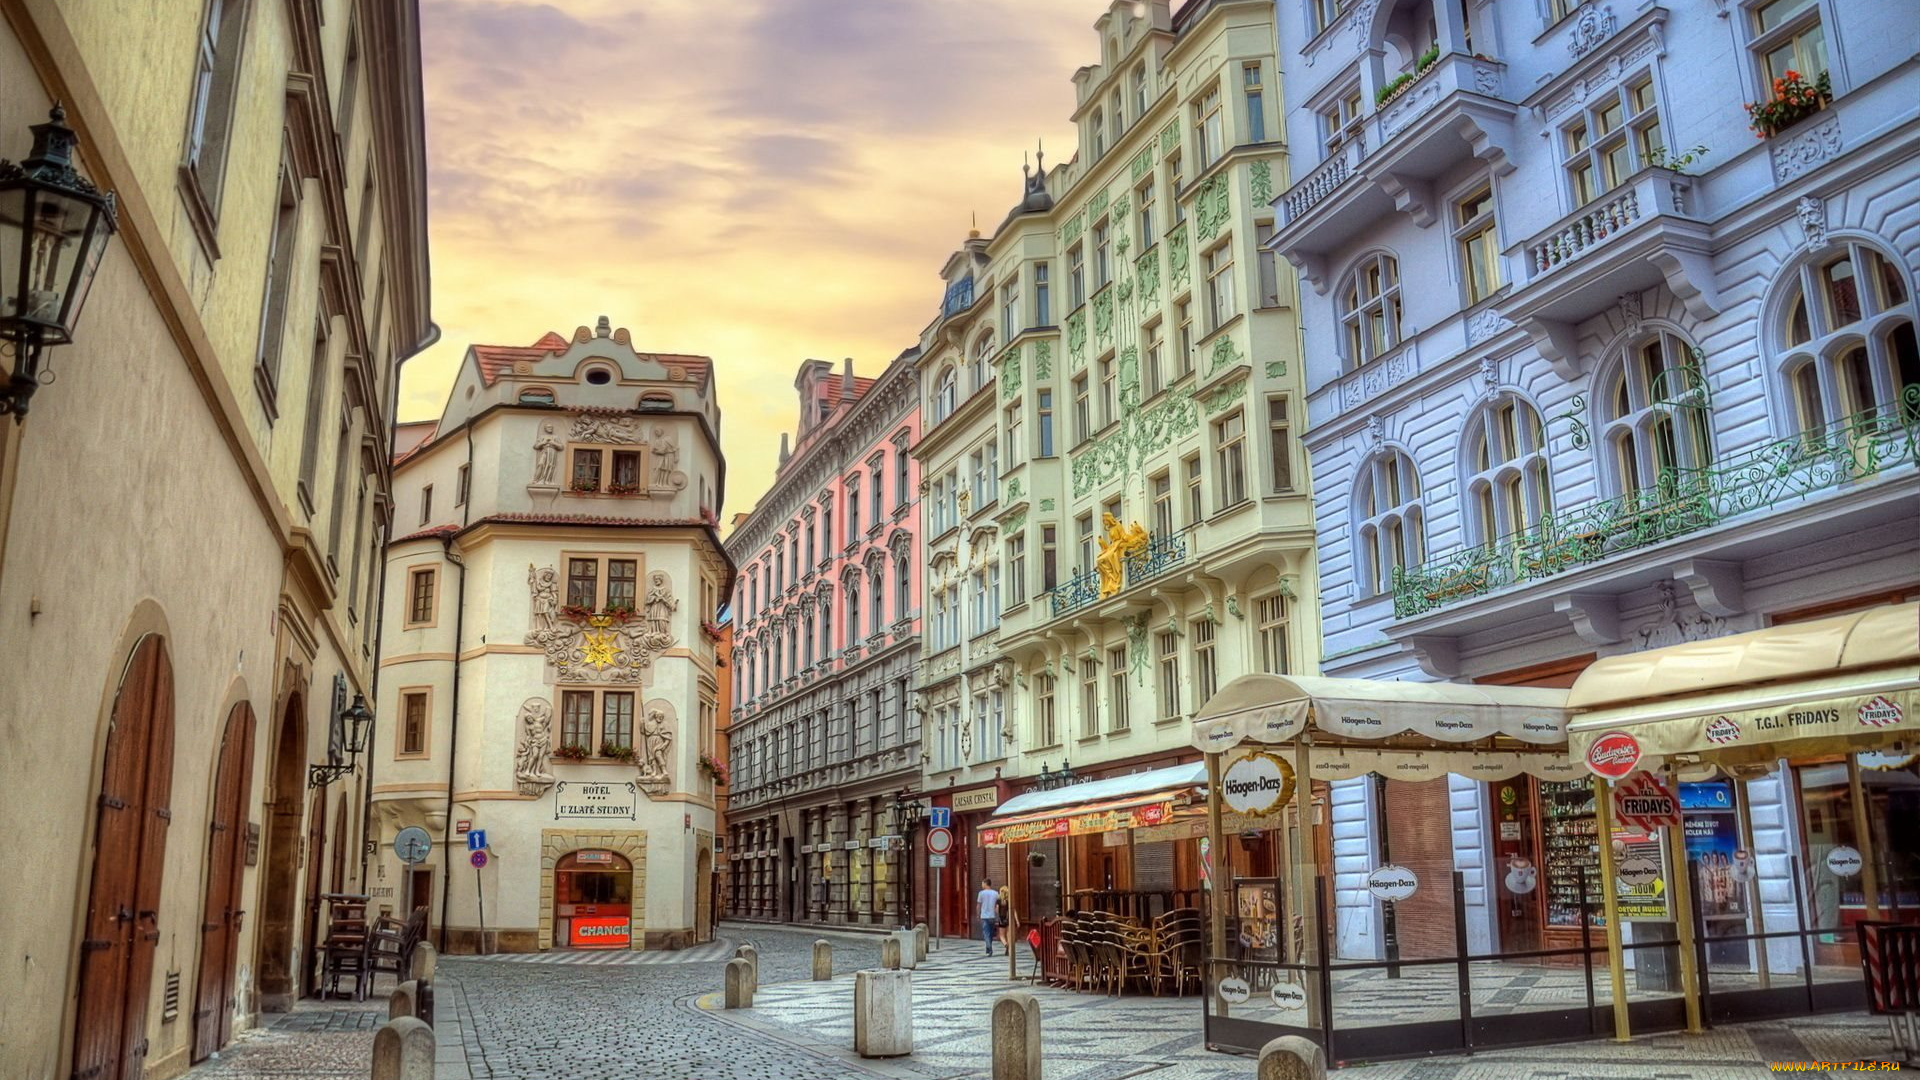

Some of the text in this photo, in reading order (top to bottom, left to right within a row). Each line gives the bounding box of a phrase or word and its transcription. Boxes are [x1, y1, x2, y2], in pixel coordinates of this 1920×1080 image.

[1341, 716, 1382, 726] Häagen-Dazs
[1755, 715, 1784, 731] T.G.I.
[583, 786, 611, 795] HOTEL
[1225, 776, 1280, 798] Häagen-Dazs
[954, 792, 994, 807] CAESAR CRYSTAL
[560, 806, 567, 814] U
[1369, 878, 1415, 890] Häagen-Dazs
[1617, 905, 1641, 913] ORTURE
[579, 925, 630, 936] CHANGE
